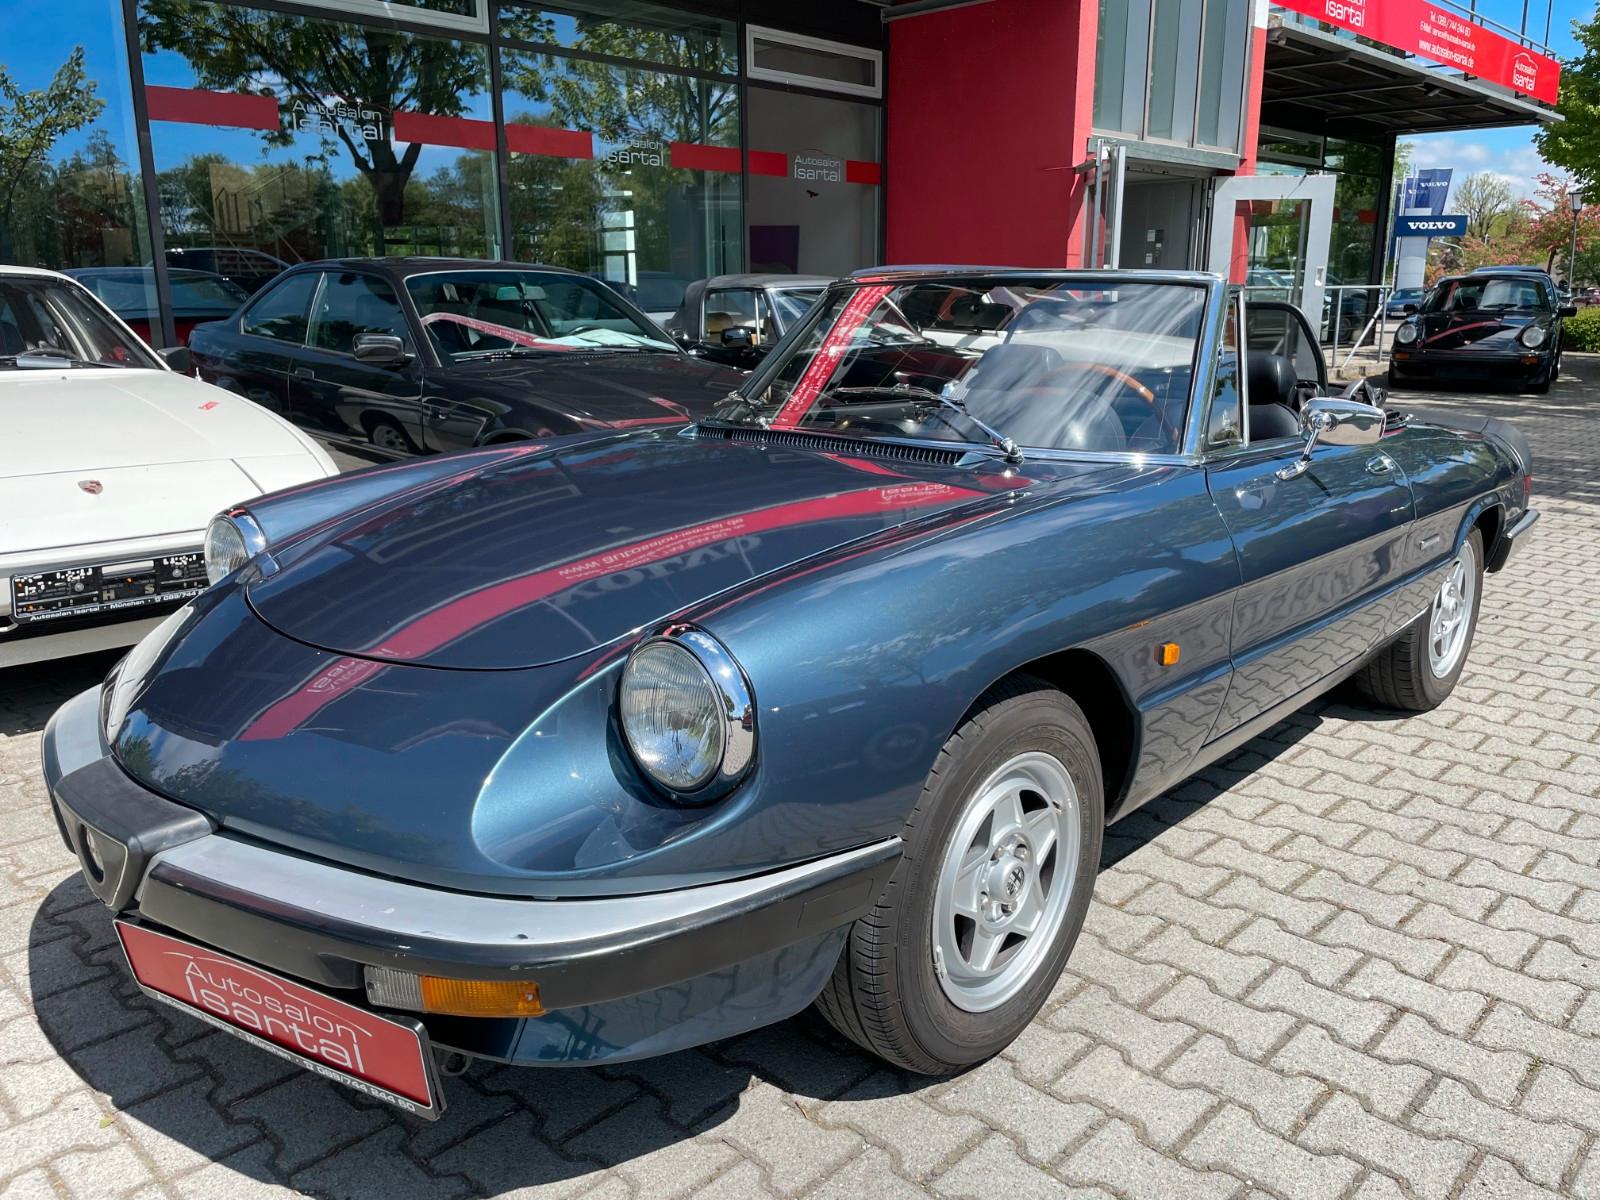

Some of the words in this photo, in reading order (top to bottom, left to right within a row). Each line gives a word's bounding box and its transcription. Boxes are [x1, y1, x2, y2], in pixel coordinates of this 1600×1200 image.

[1325, 0, 1365, 27] Isartal
[1514, 59, 1537, 77] Autosalon
[1513, 69, 1536, 91] Isartal
[292, 99, 382, 121] Autosalon
[292, 112, 384, 141] Isartal
[602, 148, 664, 167] Isartal
[794, 154, 841, 168] Autosalon
[793, 164, 841, 183] Isartal
[1407, 221, 1457, 230] VOLVO
[30, 611, 72, 621] Autosalon
[73, 605, 100, 615] Isartal
[110, 600, 145, 609] München
[185, 961, 358, 1042] Autosalon
[185, 974, 366, 1074] Isartal
